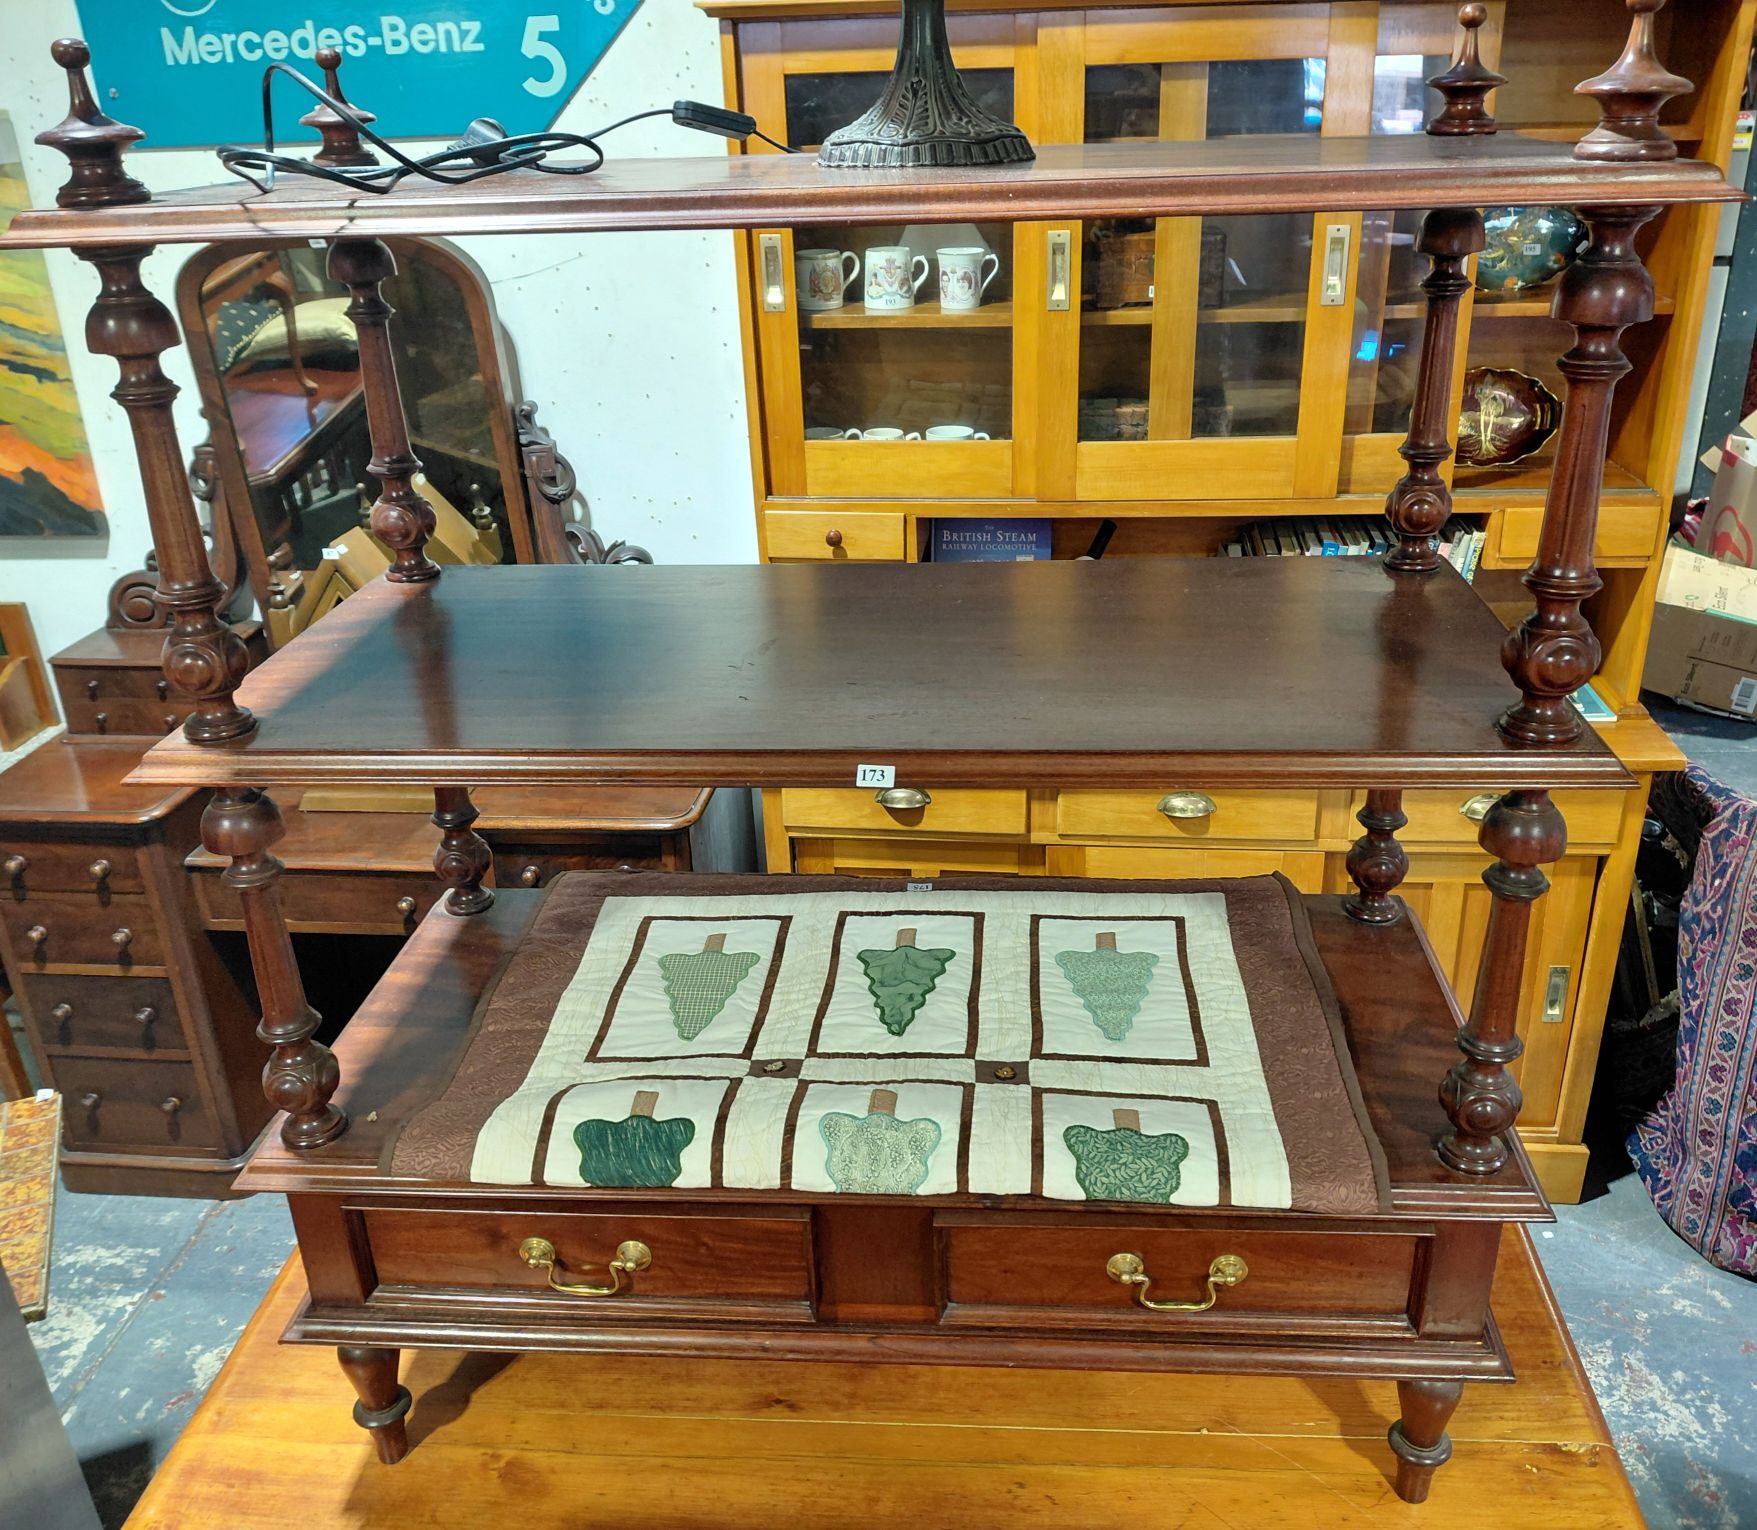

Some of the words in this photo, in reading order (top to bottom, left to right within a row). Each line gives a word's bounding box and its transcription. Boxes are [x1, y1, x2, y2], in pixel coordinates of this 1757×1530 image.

[161, 15, 485, 66] Mercedes-Benz
[521, 15, 567, 98] 5
[943, 530, 991, 542] BRITISH
[996, 530, 1037, 542] STEAM
[942, 543, 978, 551] RAILWAY
[980, 543, 1038, 551] LOCOMOTIVE
[861, 768, 885, 782] 173
